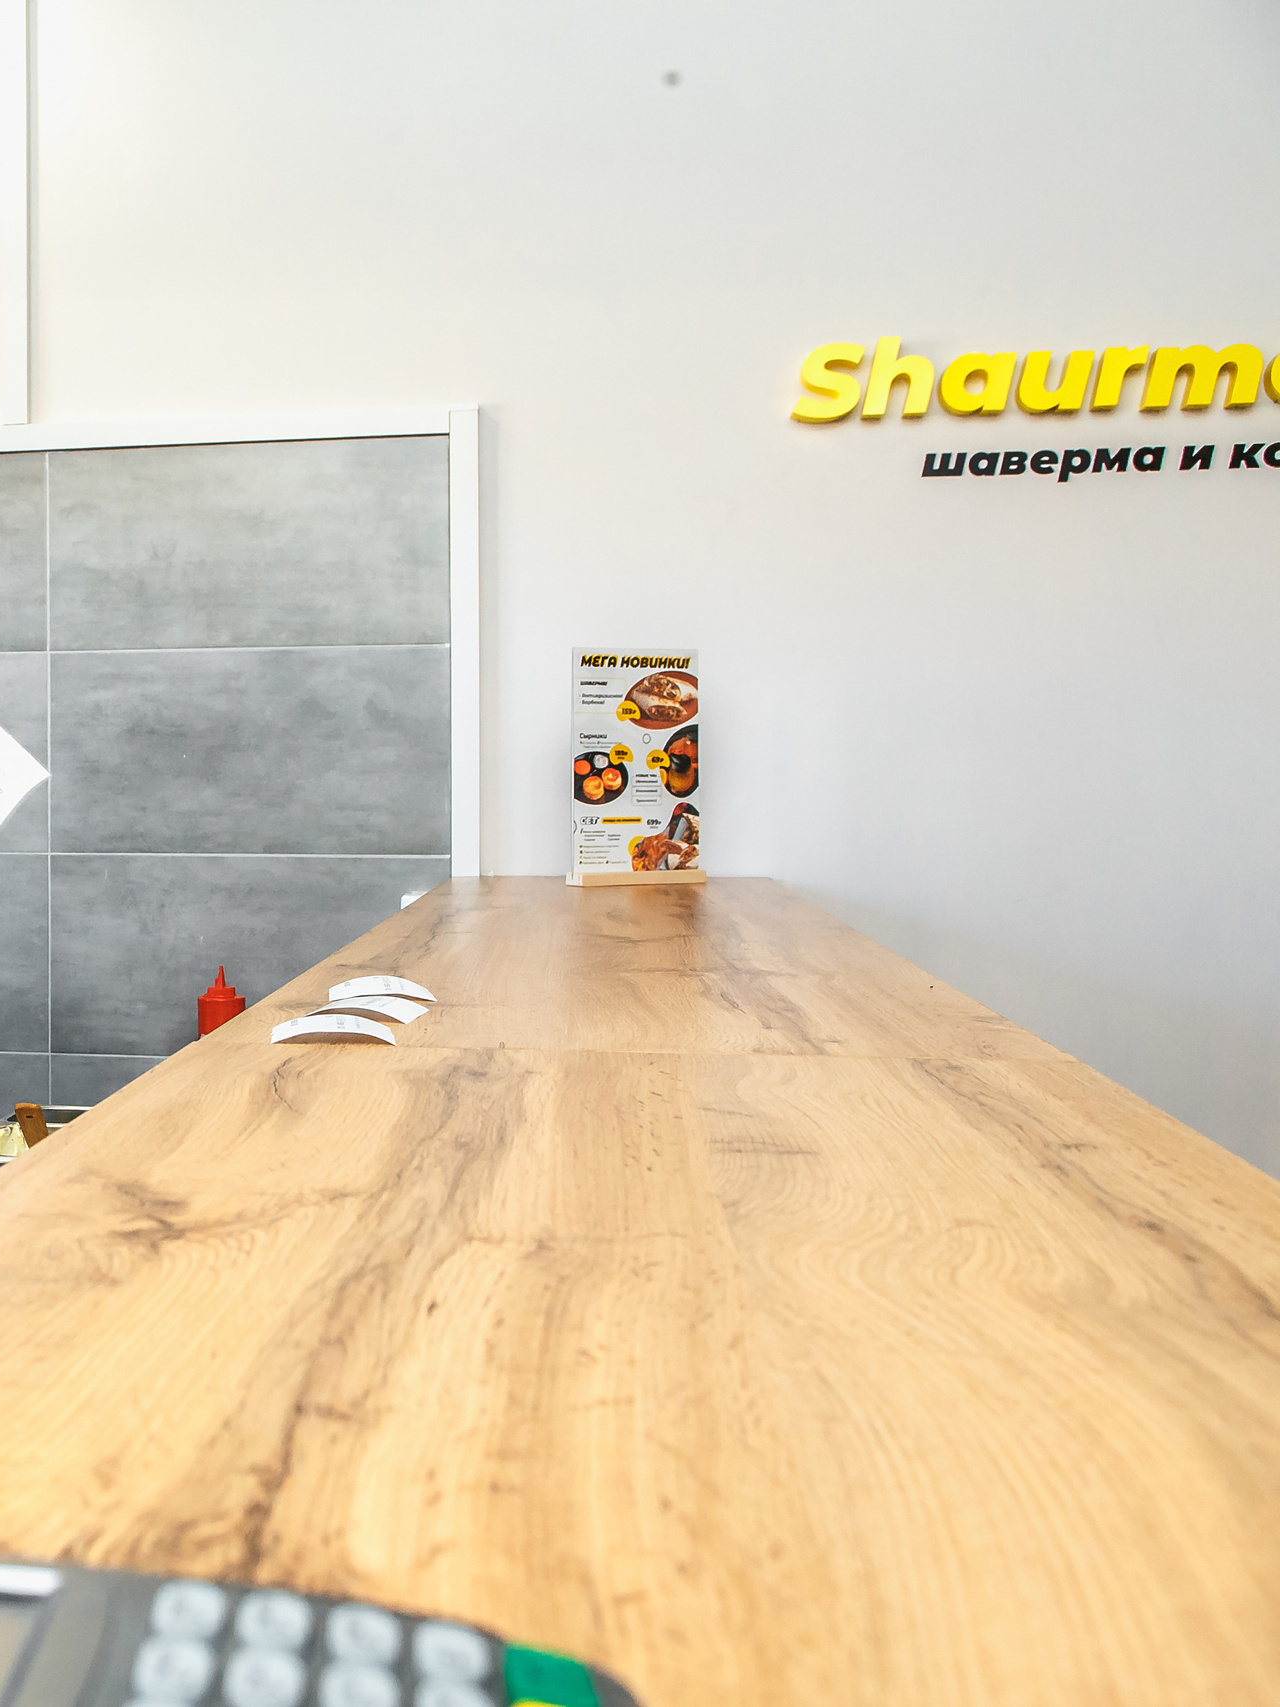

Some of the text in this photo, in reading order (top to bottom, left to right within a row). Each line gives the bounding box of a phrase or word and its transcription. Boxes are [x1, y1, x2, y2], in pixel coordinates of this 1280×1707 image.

[921, 445, 1166, 483] шаверма
[1178, 443, 1215, 470] и
[580, 654, 691, 669] МЕГА НОВИНКИ!
[580, 816, 600, 825] СЕТ
